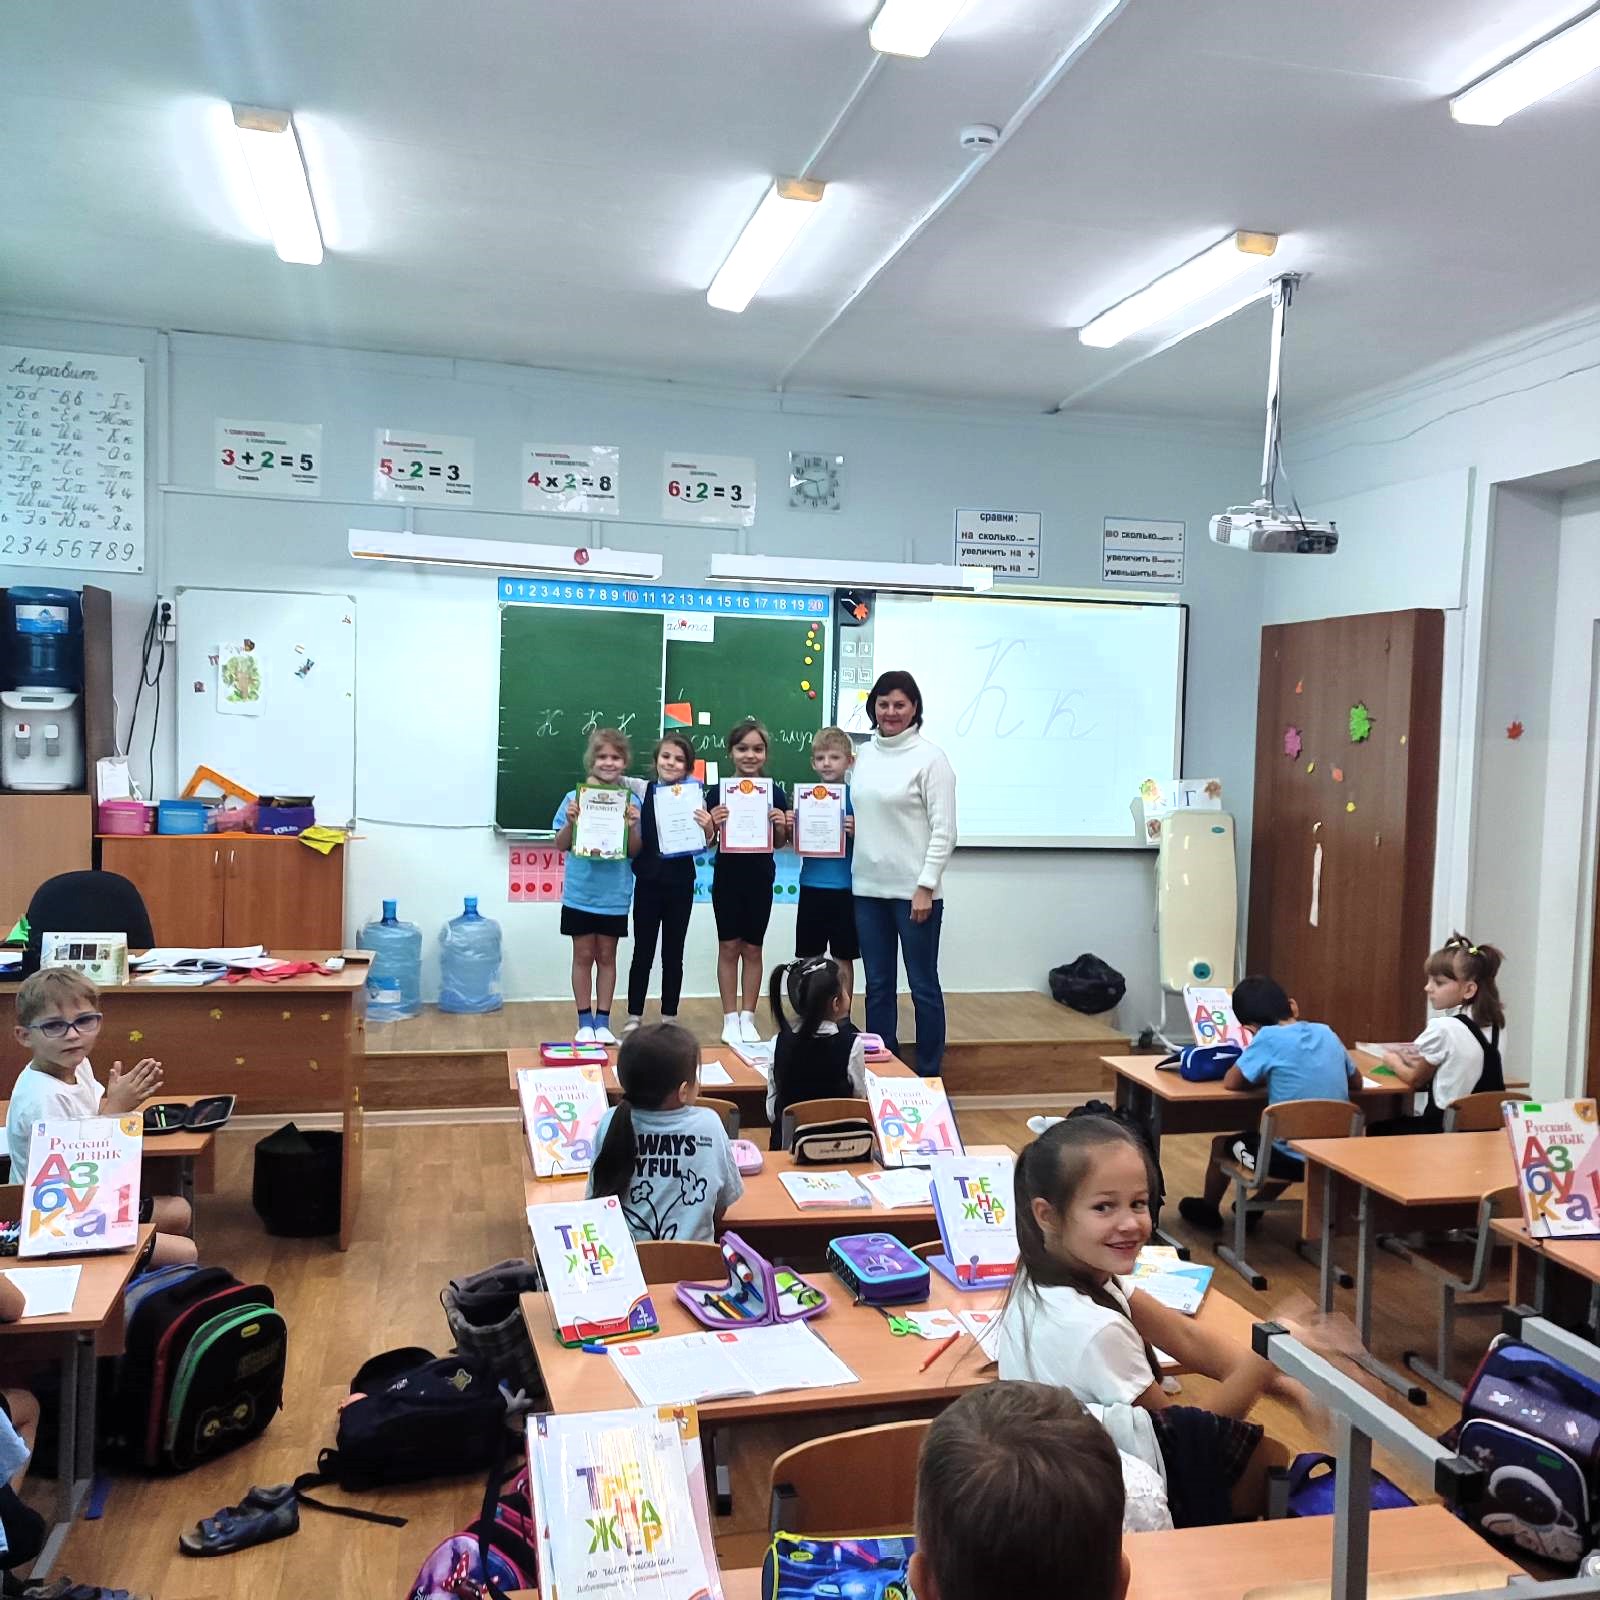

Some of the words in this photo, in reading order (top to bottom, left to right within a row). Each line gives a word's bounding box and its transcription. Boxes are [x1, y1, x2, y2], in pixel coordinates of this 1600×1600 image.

[9, 357, 99, 382] Алфавит
[221, 449, 235, 466] 3
[260, 451, 274, 468] 2
[299, 454, 313, 471] 5
[380, 459, 393, 476] 5
[410, 461, 424, 478] 2
[447, 465, 460, 481] 3
[527, 472, 541, 487] 4
[564, 473, 577, 490] 2
[599, 476, 612, 492] 8
[668, 480, 681, 497] 6
[696, 483, 709, 499] 2
[731, 485, 742, 502] 3
[961, 547, 1007, 557] увеличить
[1010, 549, 1022, 557] на
[1106, 554, 1151, 563] увеличить
[504, 583, 513, 595] 0
[518, 584, 524, 595] 1
[528, 585, 537, 597] 2
[540, 586, 549, 597] 3
[552, 586, 561, 598] 4
[564, 587, 572, 599] 5
[576, 588, 584, 599] 6
[588, 588, 596, 600] 7
[599, 589, 607, 601] 8
[611, 590, 619, 601] 9
[623, 591, 638, 602] 10
[643, 592, 655, 603] 11
[661, 593, 675, 605] 12
[680, 593, 694, 606] 13
[699, 594, 713, 607] 14
[717, 595, 732, 608] 15
[736, 596, 750, 609] 16
[755, 598, 768, 609] 17
[773, 598, 787, 610] 18
[791, 599, 805, 611] 19
[807, 599, 824, 612] 20
[956, 638, 1027, 739] К
[1525, 1119, 1573, 1136] Русский
[49, 1137, 110, 1153] Русский
[633, 1133, 697, 1156] WAYS
[1548, 1133, 1585, 1145] язык
[76, 1149, 122, 1161] язык
[634, 1158, 681, 1177] YFUL
[111, 1183, 134, 1224] 1
